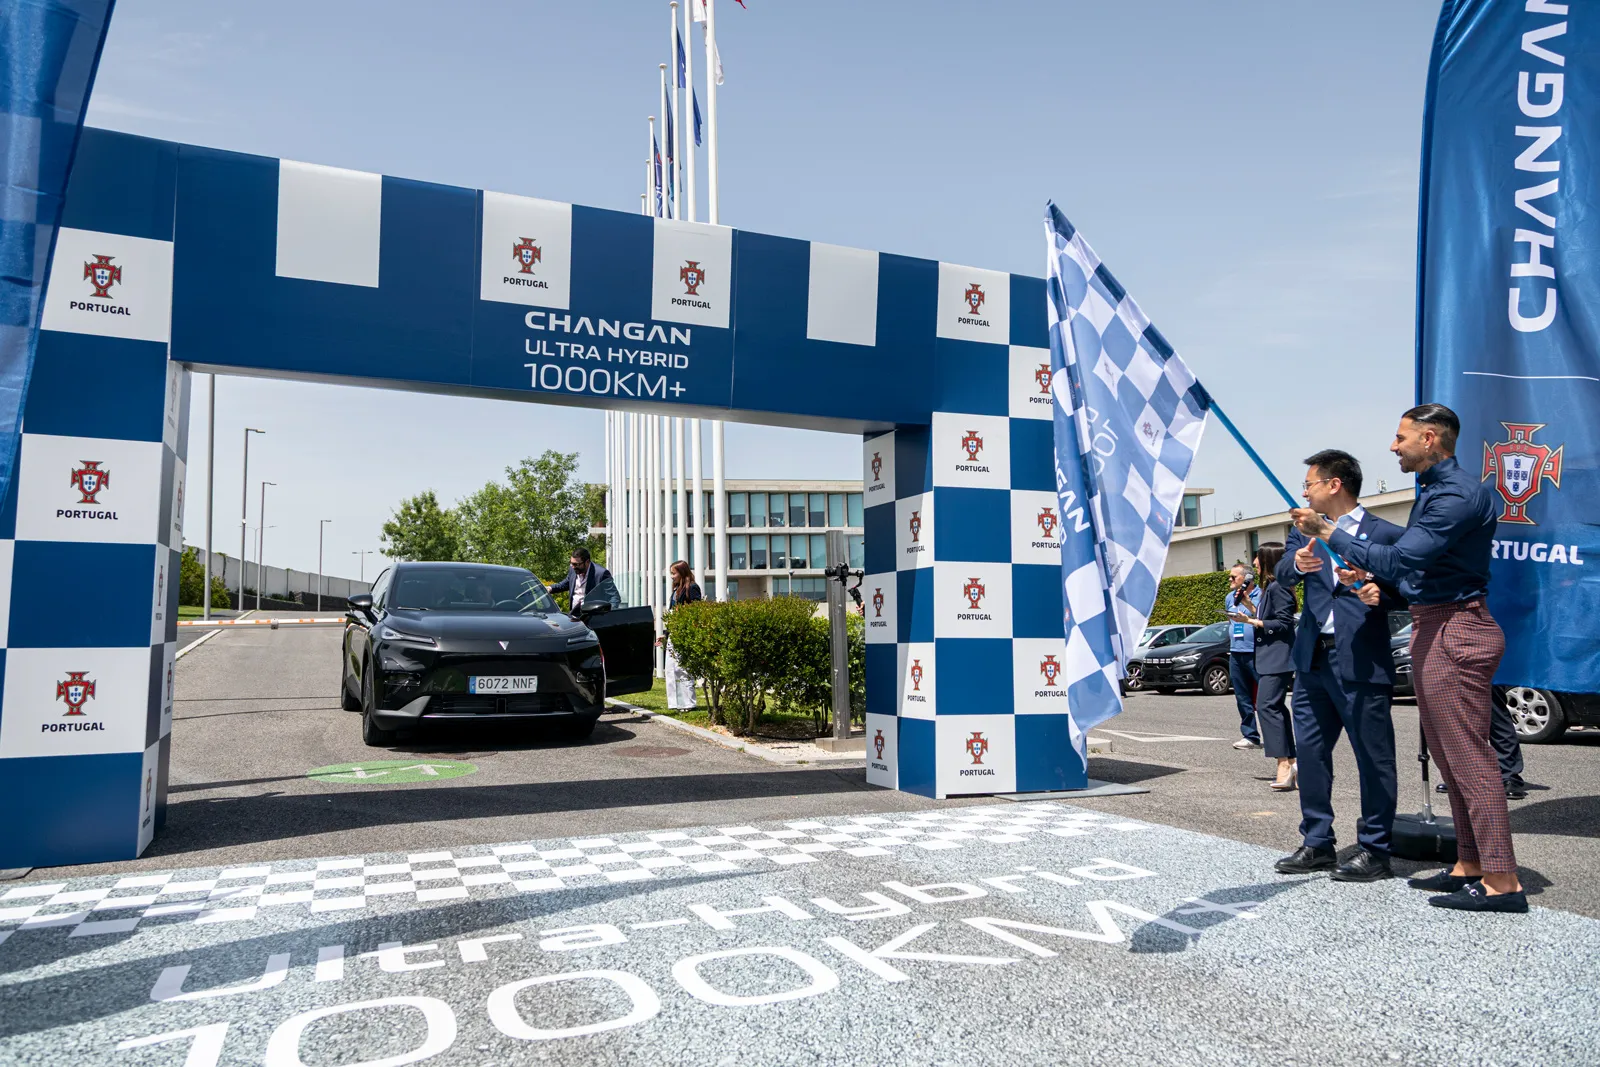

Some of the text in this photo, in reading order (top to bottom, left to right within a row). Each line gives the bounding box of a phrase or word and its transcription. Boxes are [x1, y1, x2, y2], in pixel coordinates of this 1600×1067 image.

[503, 276, 549, 289] PORTUGAL
[69, 300, 131, 316] PORTUGAL
[671, 297, 711, 310] PORTUGAL
[957, 316, 990, 327] PORTUGAL
[524, 311, 691, 346] CHANGAN
[525, 338, 689, 369] ULTRA HYBRID
[523, 363, 686, 399] 1000KM+
[1029, 396, 1053, 405] PORTUG
[955, 464, 990, 473] PORTUGAL
[868, 482, 886, 493] PORTUGAL
[56, 508, 119, 521] PORTUGAL
[906, 544, 926, 554] PORTUGAL
[1031, 541, 1061, 549] PORTUGA
[1491, 539, 1584, 565] RTUGAL
[957, 613, 992, 621] PORTUGAL
[478, 678, 509, 689] 6072
[512, 678, 536, 689] NNF
[907, 694, 927, 703] PORTUGAL
[1034, 690, 1068, 698] PORTUGAL
[41, 722, 105, 733] PORTUGAL
[871, 762, 889, 772] PORTUGAL
[959, 768, 995, 777] PORTUGAL
